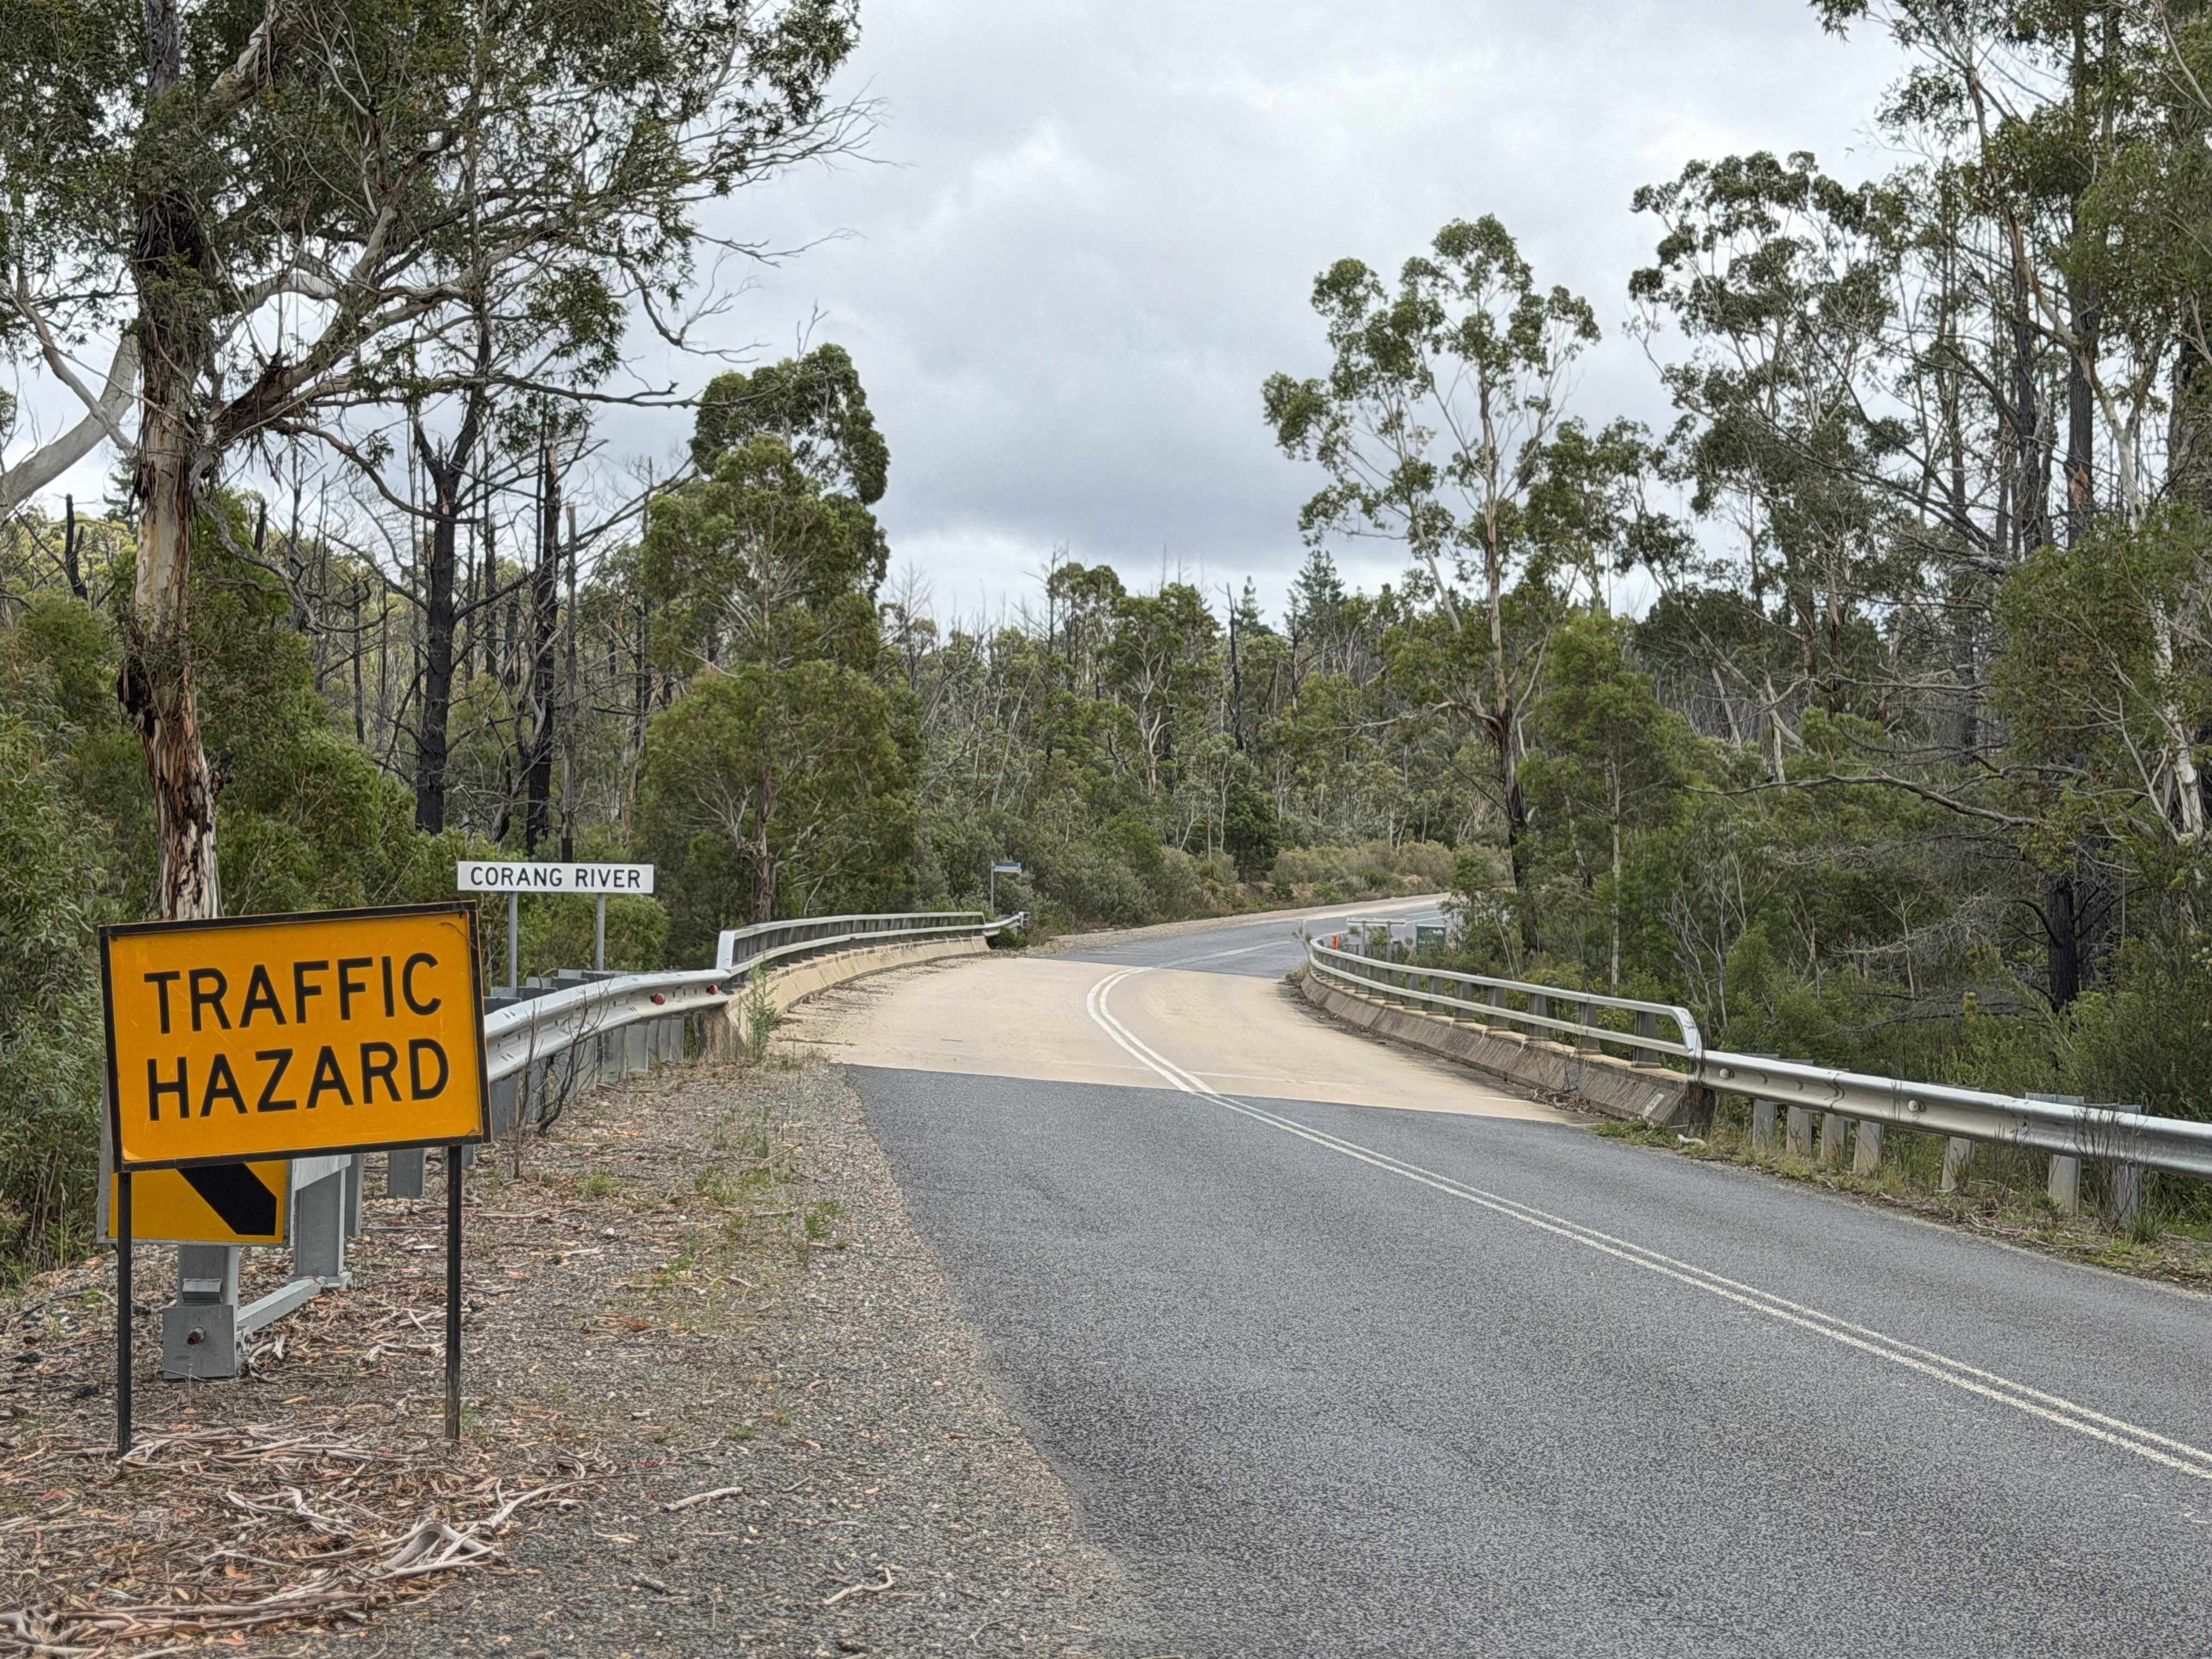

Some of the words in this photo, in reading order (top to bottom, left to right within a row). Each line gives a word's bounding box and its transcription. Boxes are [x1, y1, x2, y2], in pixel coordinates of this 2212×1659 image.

[471, 866, 562, 887] CORANG
[575, 868, 640, 888] RIVER
[144, 952, 442, 1035] TRAFFIC
[147, 1039, 449, 1121] HAZARD
